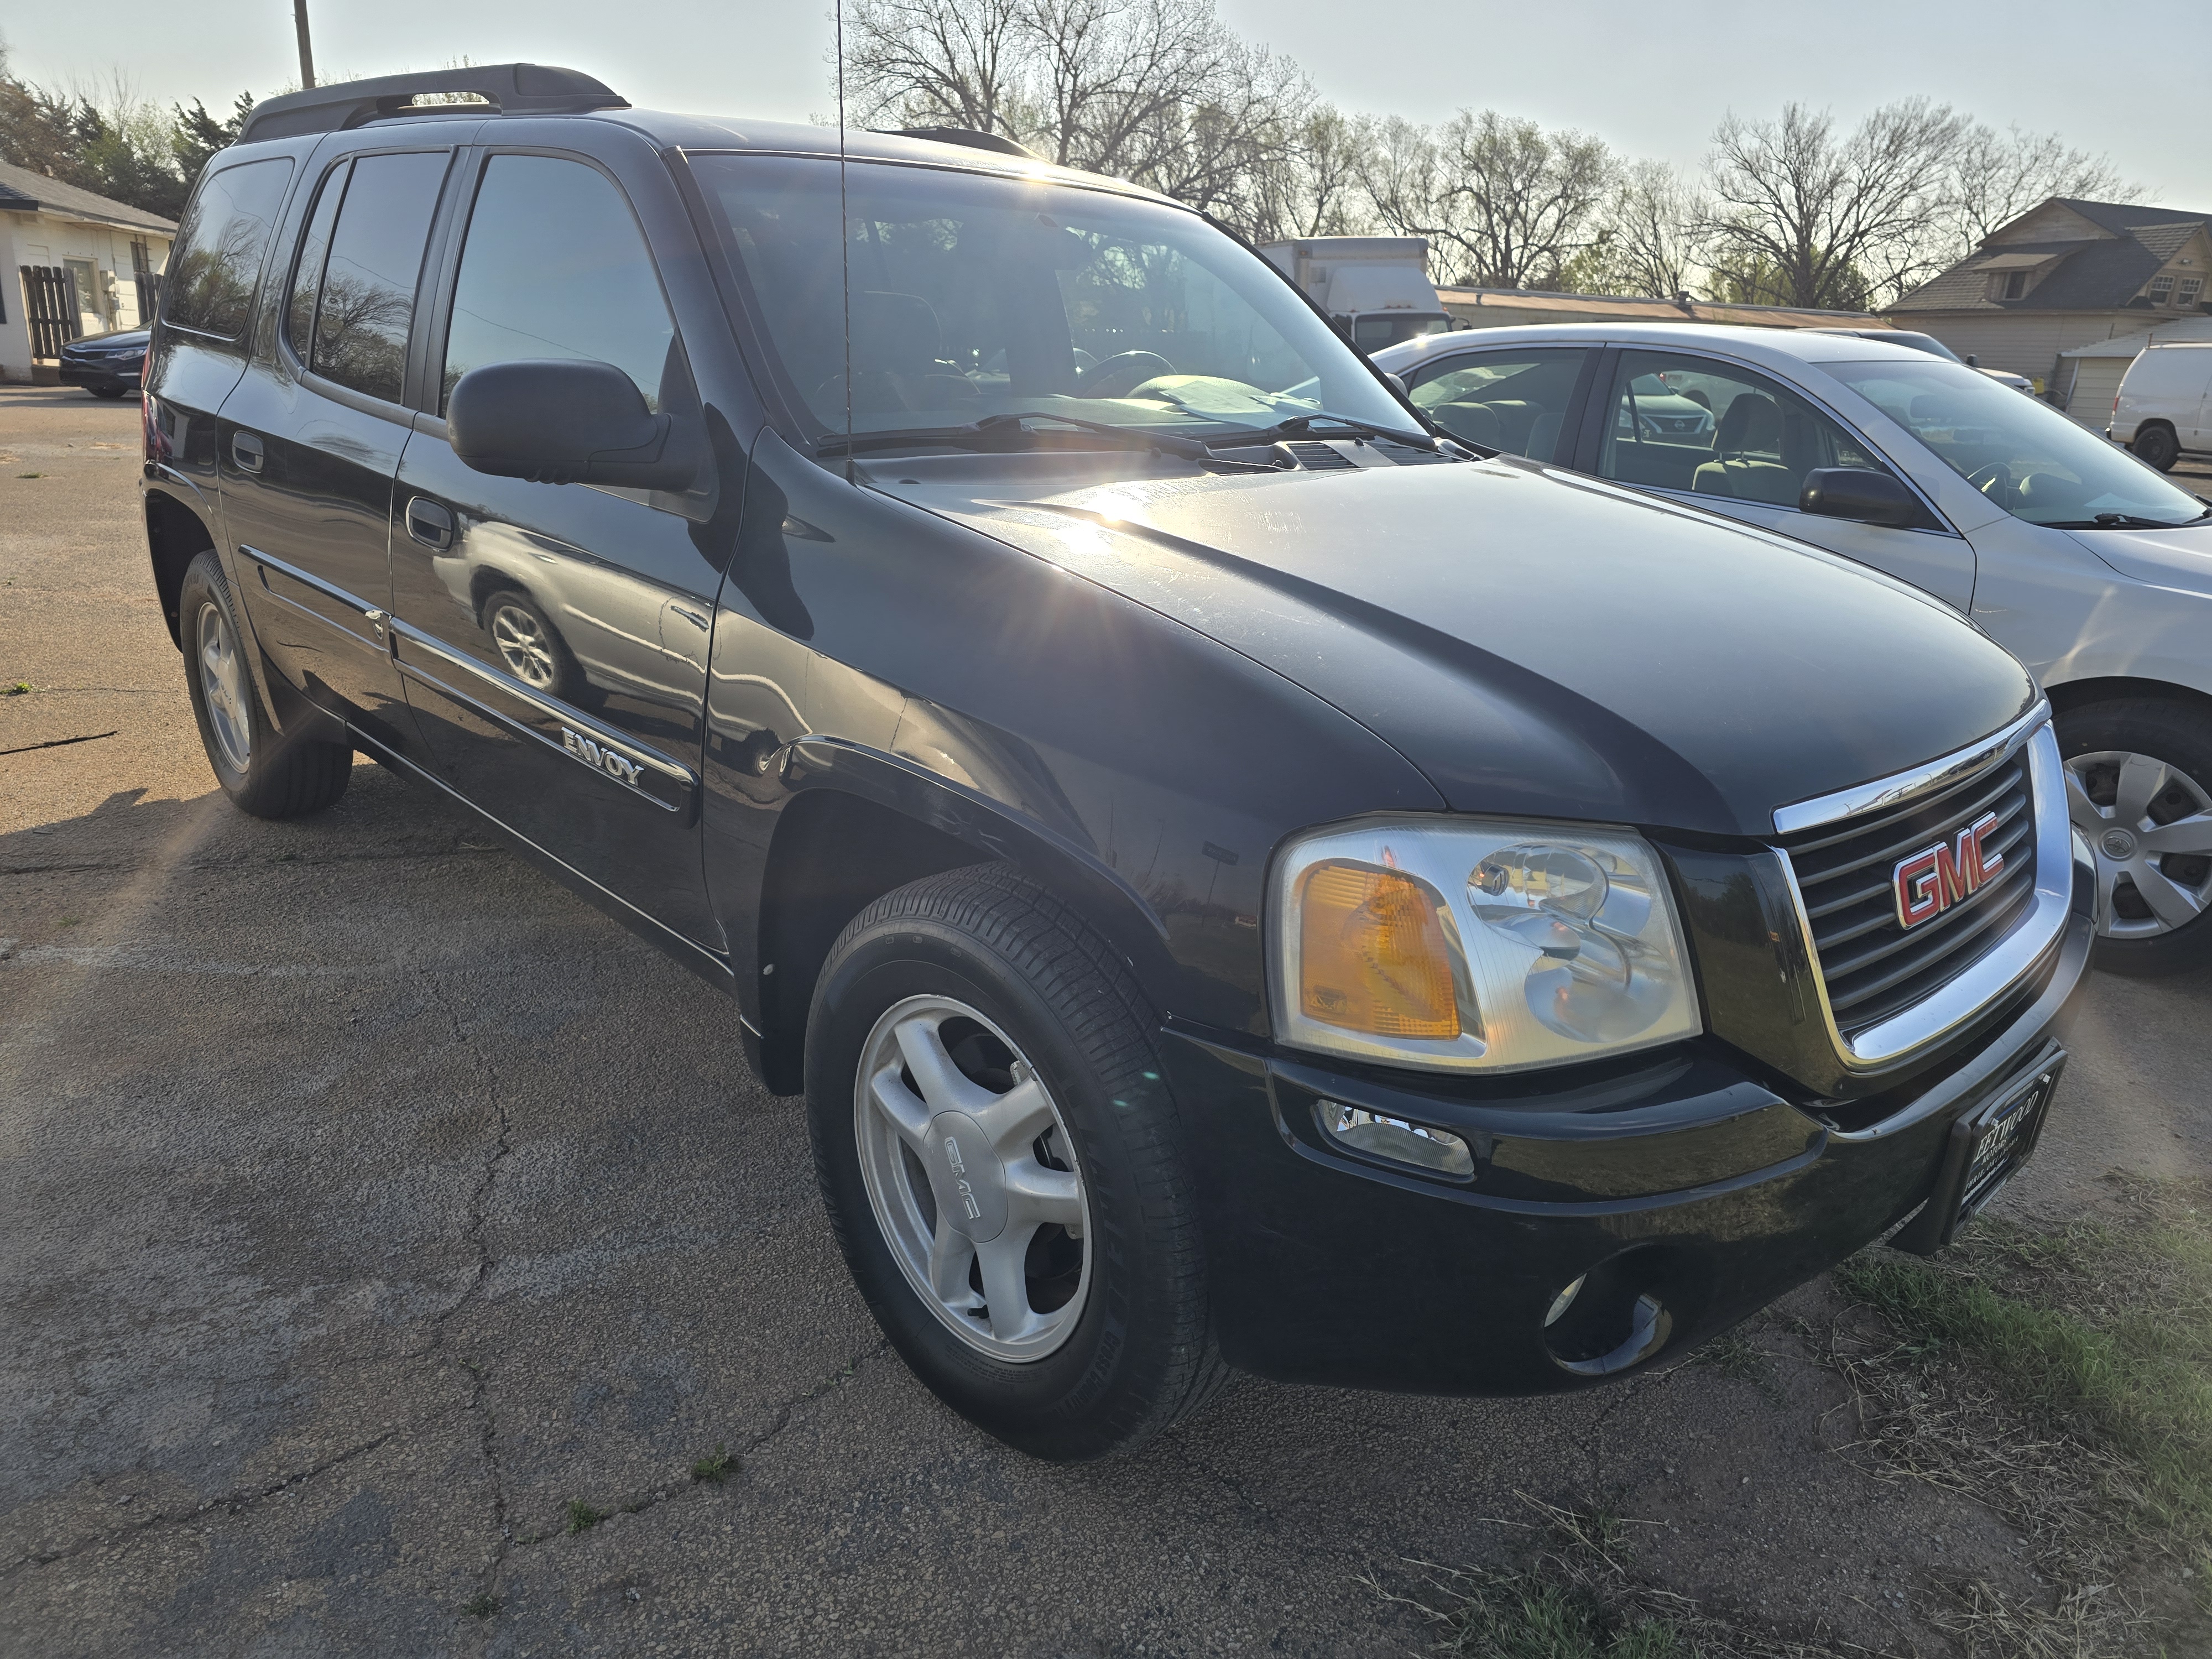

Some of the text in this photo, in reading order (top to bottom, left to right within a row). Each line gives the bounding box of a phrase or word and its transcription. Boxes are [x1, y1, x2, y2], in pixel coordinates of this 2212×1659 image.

[561, 726, 645, 786] ENVOY
[1892, 811, 2005, 931] GMC
[1973, 1091, 2039, 1164] EETWOOD
[944, 1136, 981, 1219] GMC
